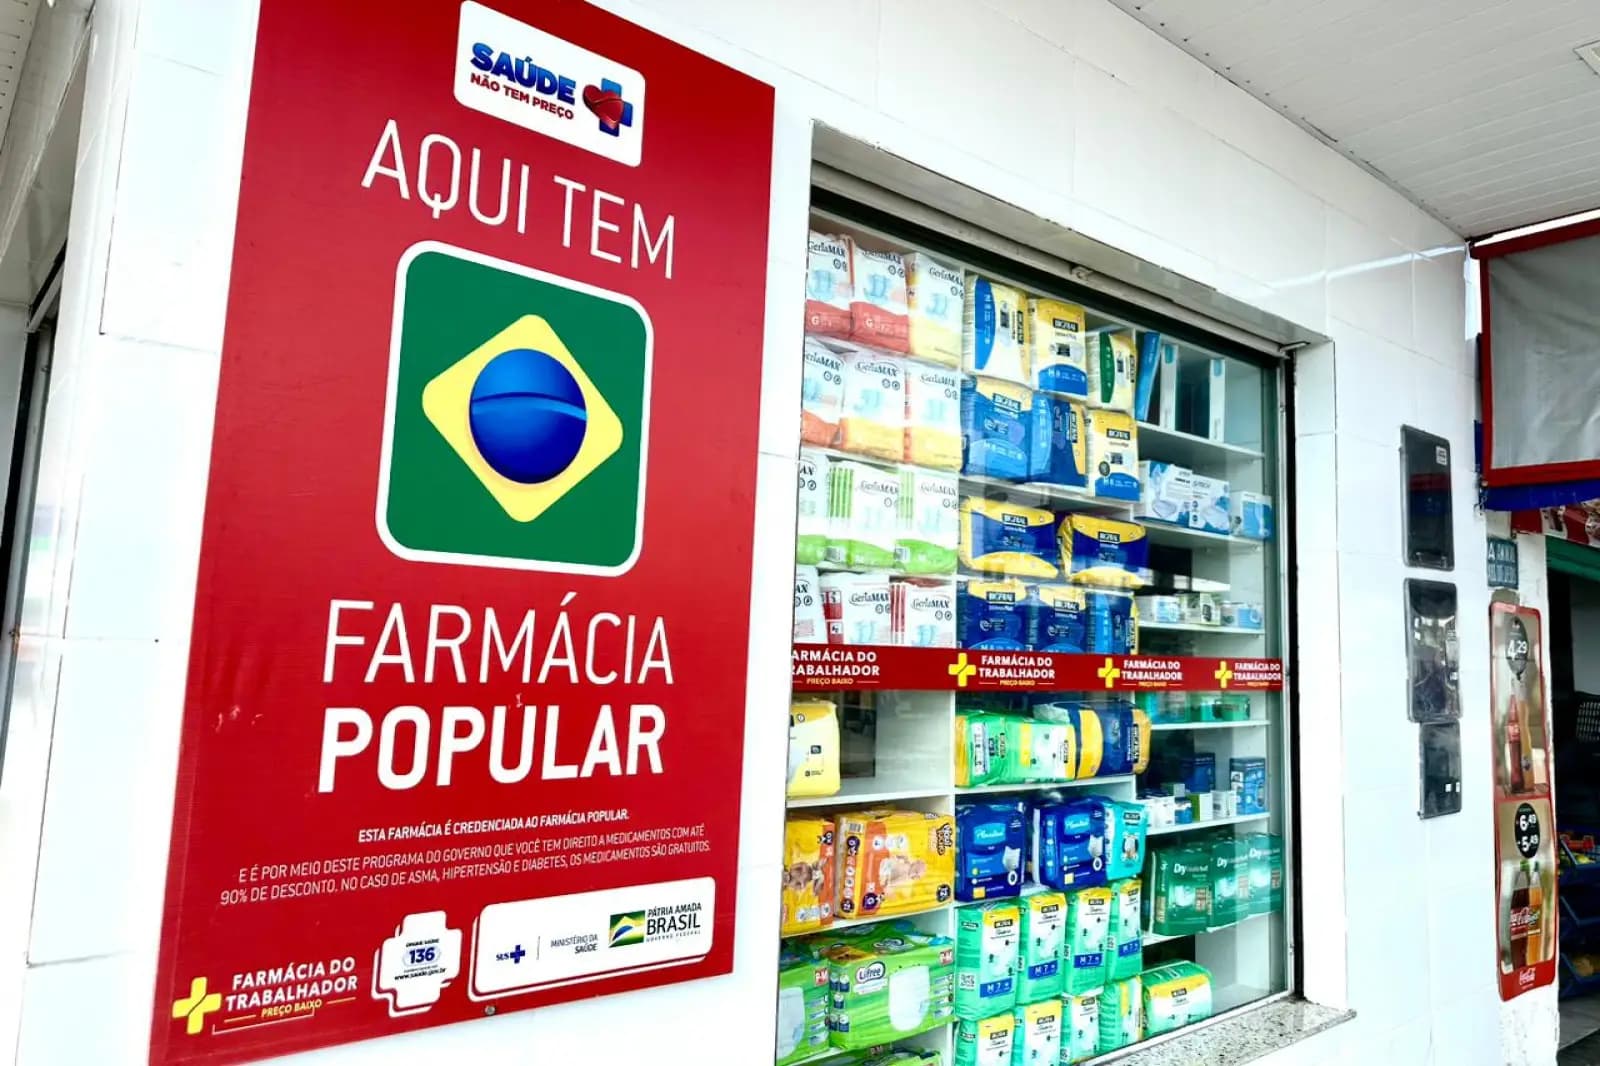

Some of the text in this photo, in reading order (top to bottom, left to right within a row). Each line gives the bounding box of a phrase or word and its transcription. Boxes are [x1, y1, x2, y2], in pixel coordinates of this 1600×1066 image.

[471, 42, 576, 105] SAÚDE
[470, 71, 575, 121] NÃO TEM PREÇO
[360, 119, 675, 280] AQUI TEM
[805, 351, 841, 371] eriaMAX
[322, 591, 674, 685] FARMÁCIA
[791, 647, 877, 662] ARMÁCIA DO
[981, 652, 1053, 667] FARMÁCIA DO
[1123, 658, 1181, 670] FARMÁCIA DO
[791, 664, 880, 676] RABALHADOR
[978, 667, 1056, 680] TRABALHADOR
[1121, 670, 1183, 681] TRABALHADOR
[1234, 661, 1281, 671] FARMÁCIA DO
[806, 677, 831, 686] PREÇO
[1233, 672, 1282, 681] TRABALHADOR
[318, 703, 666, 793] POPULAR
[358, 808, 629, 843] ESTA FARMÁCIA É CREDENCIADA AO FARMÁCIA POPULAR.
[239, 822, 705, 883] E É POR MEIO DESTE PROGRAMA DO GOVERNO QUE VOCÊ TEM DIREITO A MEDICAMENTOS COM ATÉ
[220, 839, 711, 906] 90% DE DESCONTO. NO CASO DE ASMA, HIPERTENSÃO E DIABETES, OS MEDICAMENTOS SÃO GRATUITOS.
[647, 902, 702, 918] PÁTRIA AMADA
[646, 912, 701, 936] BRASIL
[550, 933, 598, 948] MINISTÉRIO DA
[574, 943, 598, 954] SAÚDE
[409, 946, 435, 965] 136
[232, 957, 355, 991] FARMÁCIA DO
[225, 976, 358, 1012] TRABALHADOR
[261, 998, 323, 1019] PREÇO BAIXO
